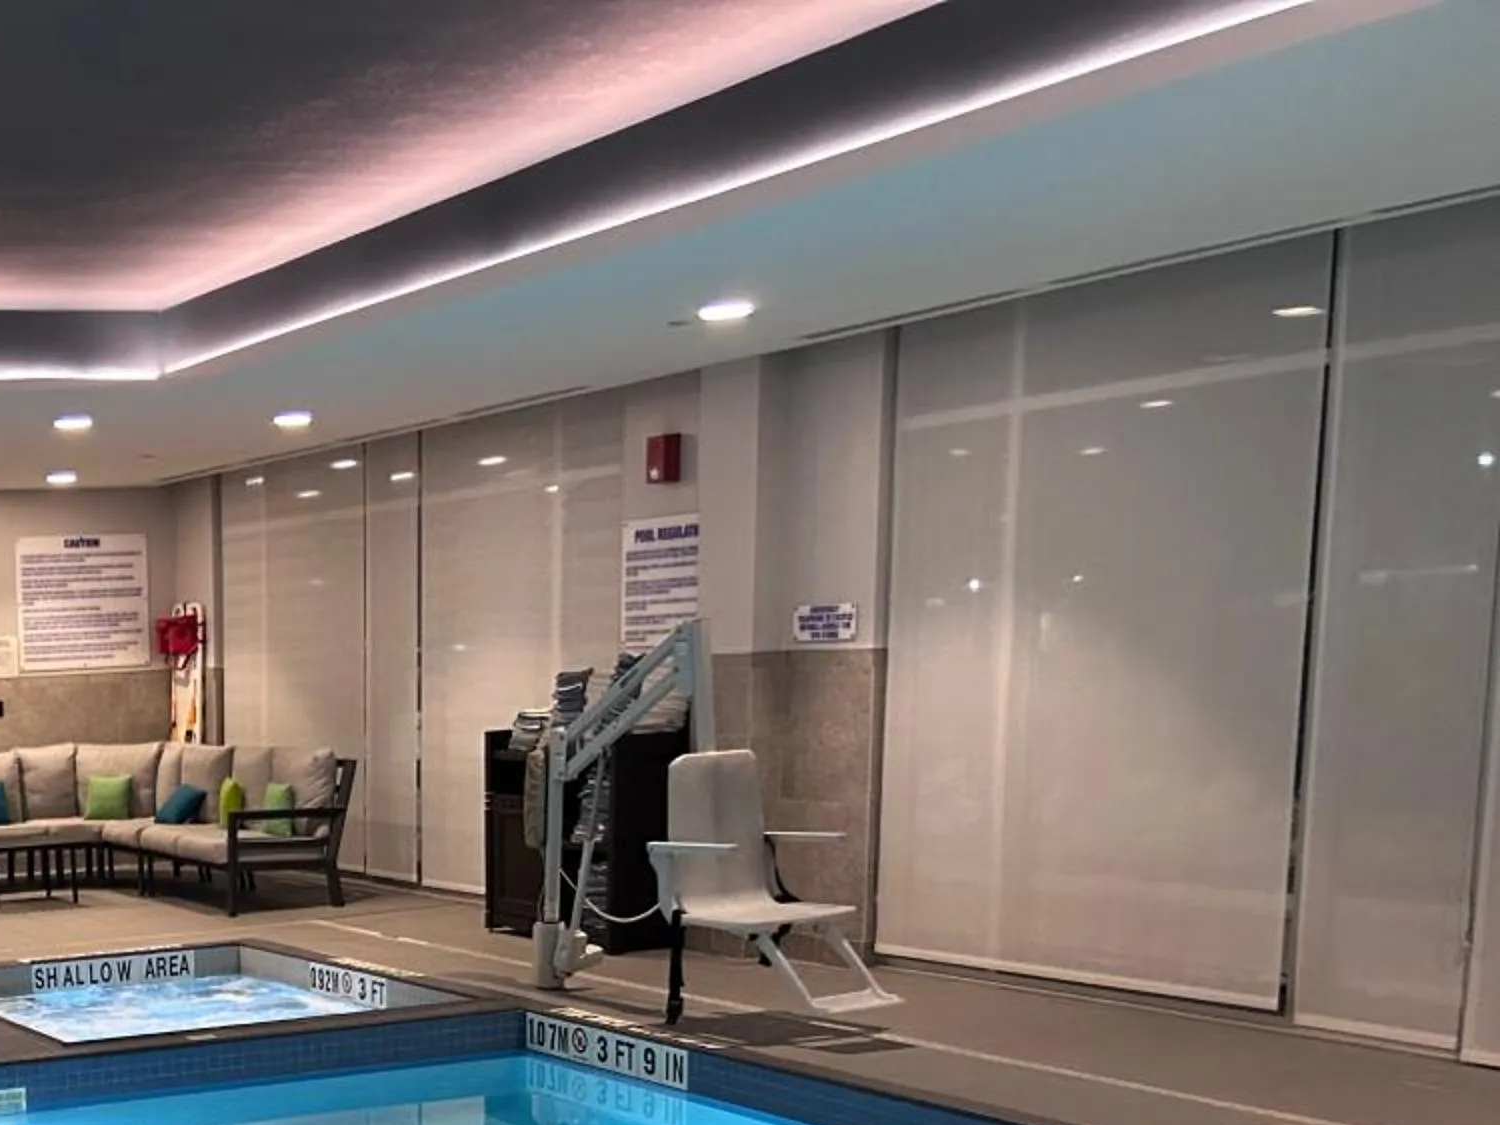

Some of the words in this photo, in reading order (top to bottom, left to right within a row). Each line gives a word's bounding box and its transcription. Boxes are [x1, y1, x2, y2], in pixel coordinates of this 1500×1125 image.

[34, 960, 132, 989] SHALLOW
[145, 954, 190, 979] AREA
[358, 977, 367, 1000] 3
[371, 980, 385, 1005] FT
[597, 1036, 609, 1062] 3
[615, 1040, 635, 1071] FT
[643, 1048, 656, 1075] 9
[665, 1052, 684, 1084] IN
